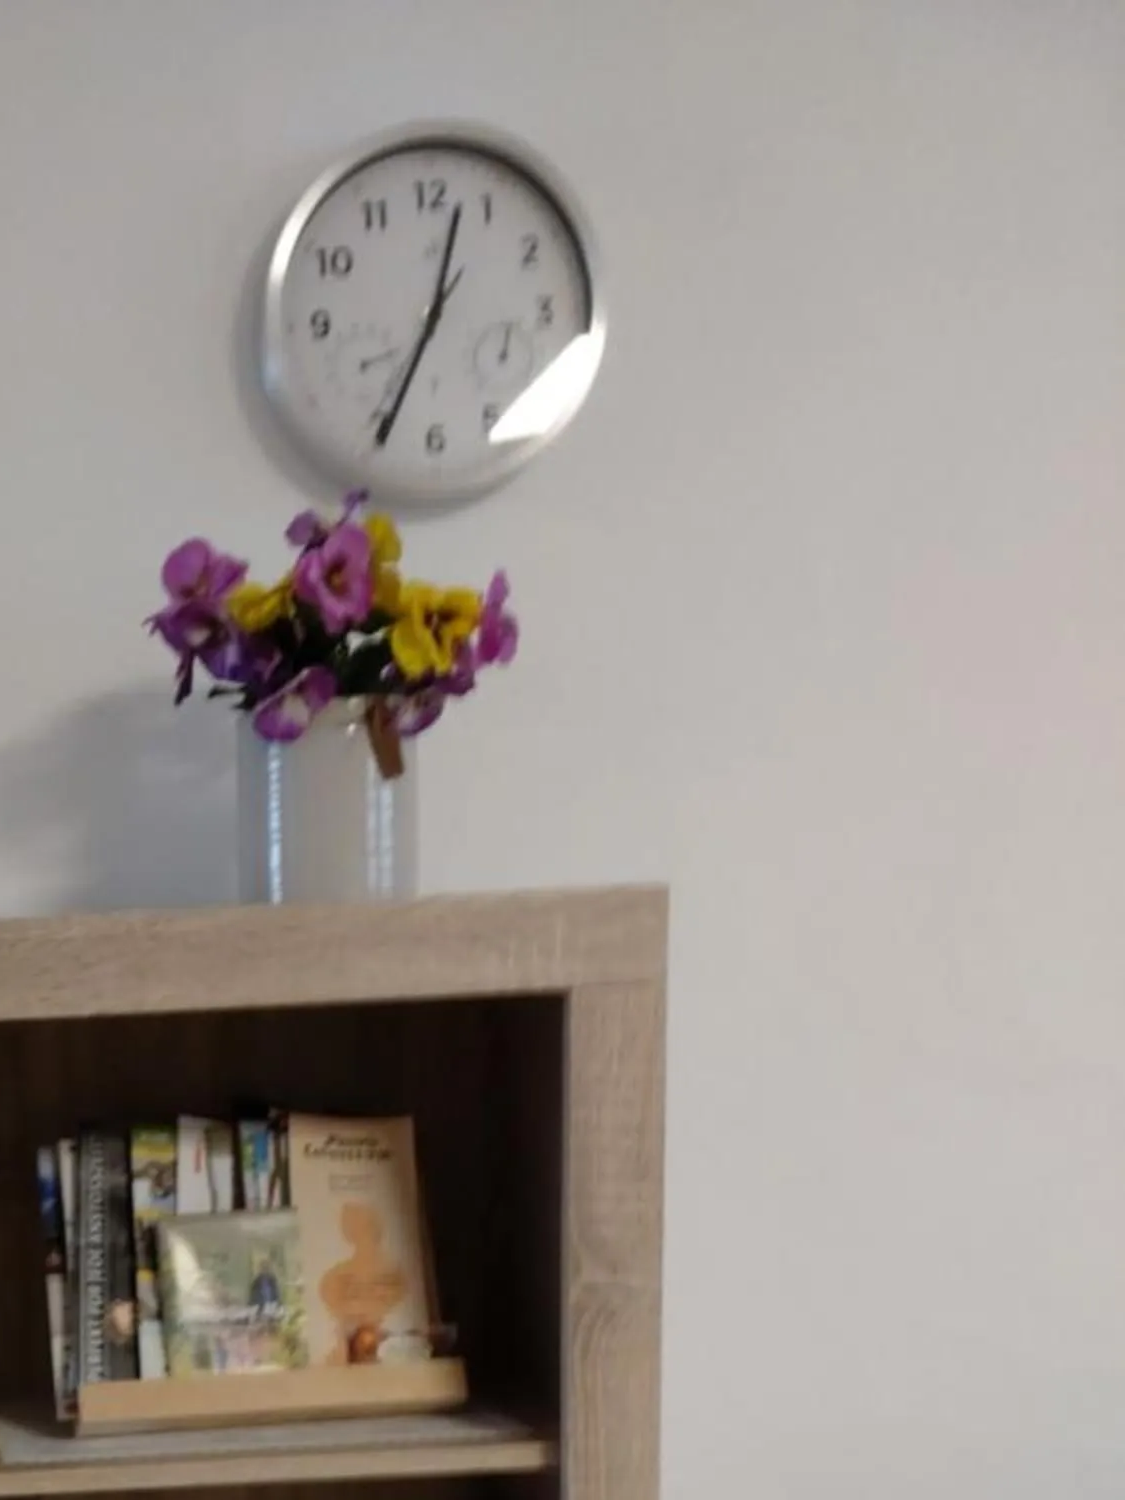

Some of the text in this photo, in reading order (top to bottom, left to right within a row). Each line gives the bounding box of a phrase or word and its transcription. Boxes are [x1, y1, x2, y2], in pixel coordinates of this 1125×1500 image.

[414, 179, 446, 212] 12
[482, 195, 491, 225] 1
[363, 200, 388, 231] 11
[317, 246, 353, 277] 10
[521, 235, 538, 267] 2
[310, 310, 330, 339] 9
[537, 295, 553, 326] 3
[426, 423, 446, 456] 6
